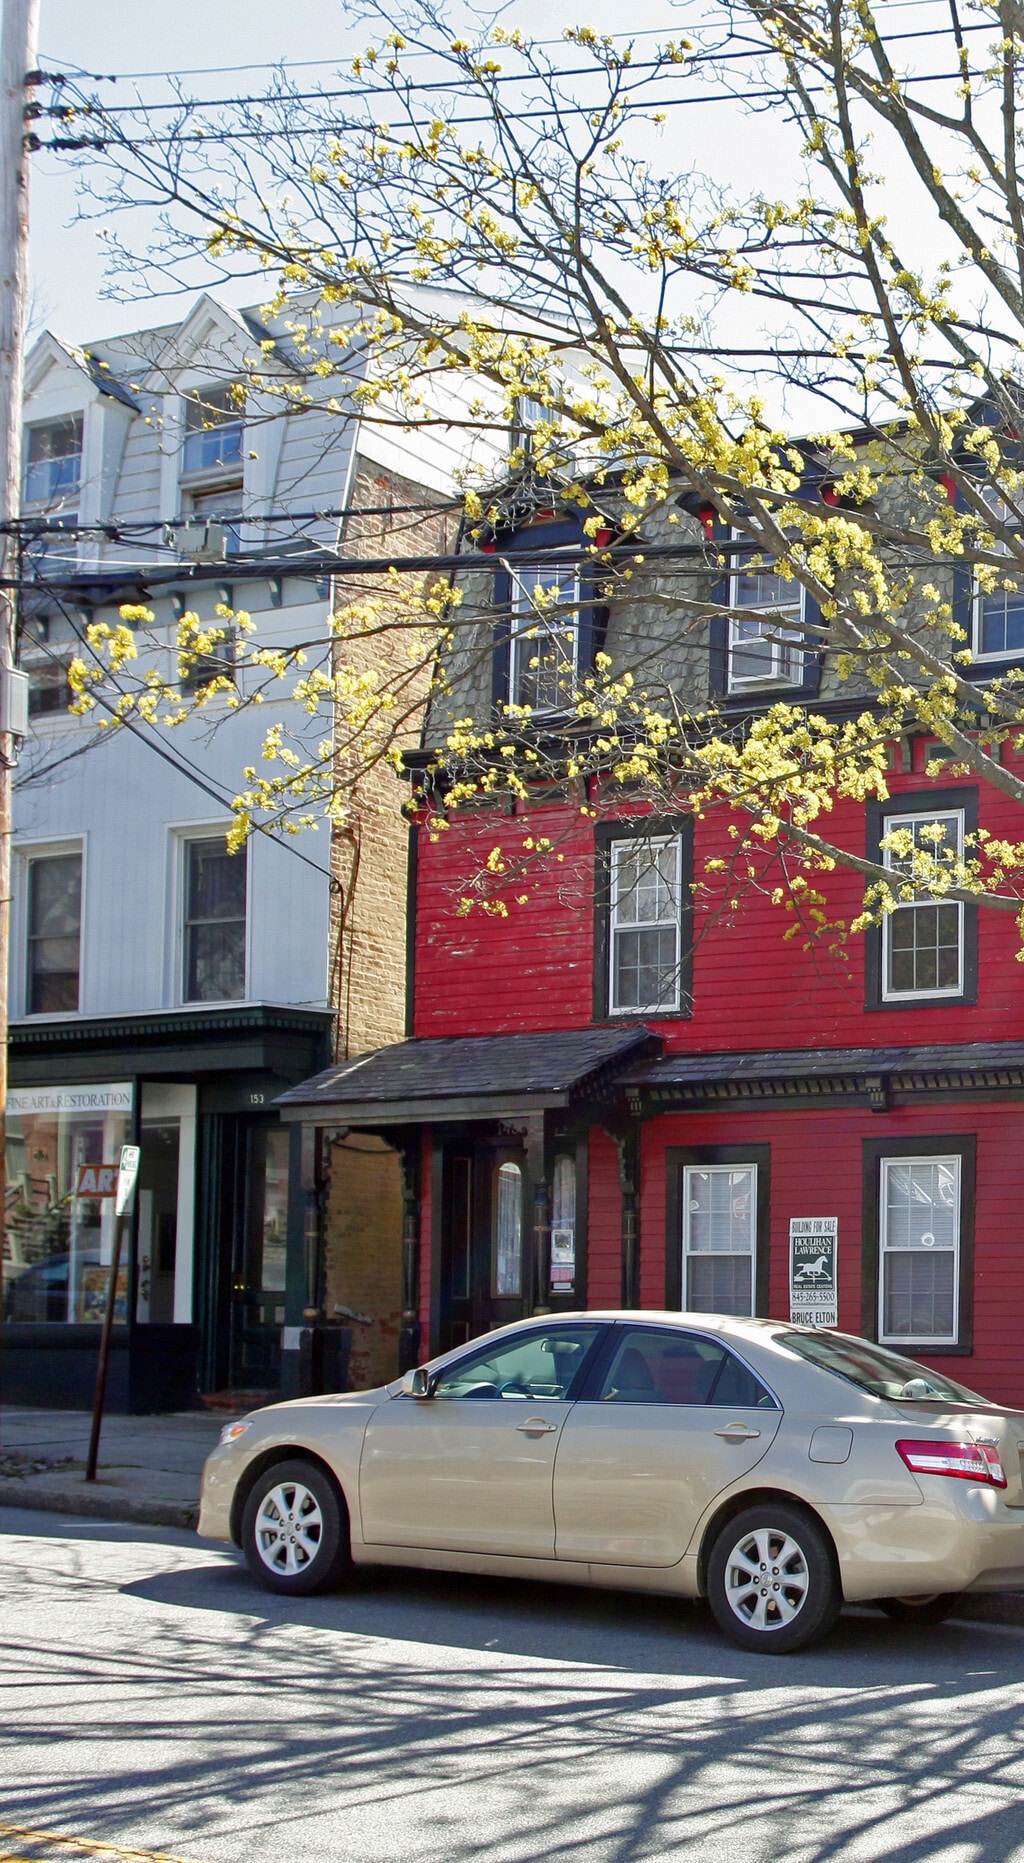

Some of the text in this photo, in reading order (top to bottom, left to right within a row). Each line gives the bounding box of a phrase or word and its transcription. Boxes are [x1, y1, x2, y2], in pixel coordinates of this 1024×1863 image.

[56, 1093, 130, 1108] RESTORATION
[250, 1094, 264, 1104] 153
[79, 1168, 120, 1193] AR
[792, 1220, 835, 1233] BUILDING FOR SALE
[795, 1237, 832, 1246] HOULIHAN
[794, 1246, 832, 1255] LAWRENCE
[792, 1312, 835, 1324] BRUCE ELTON
